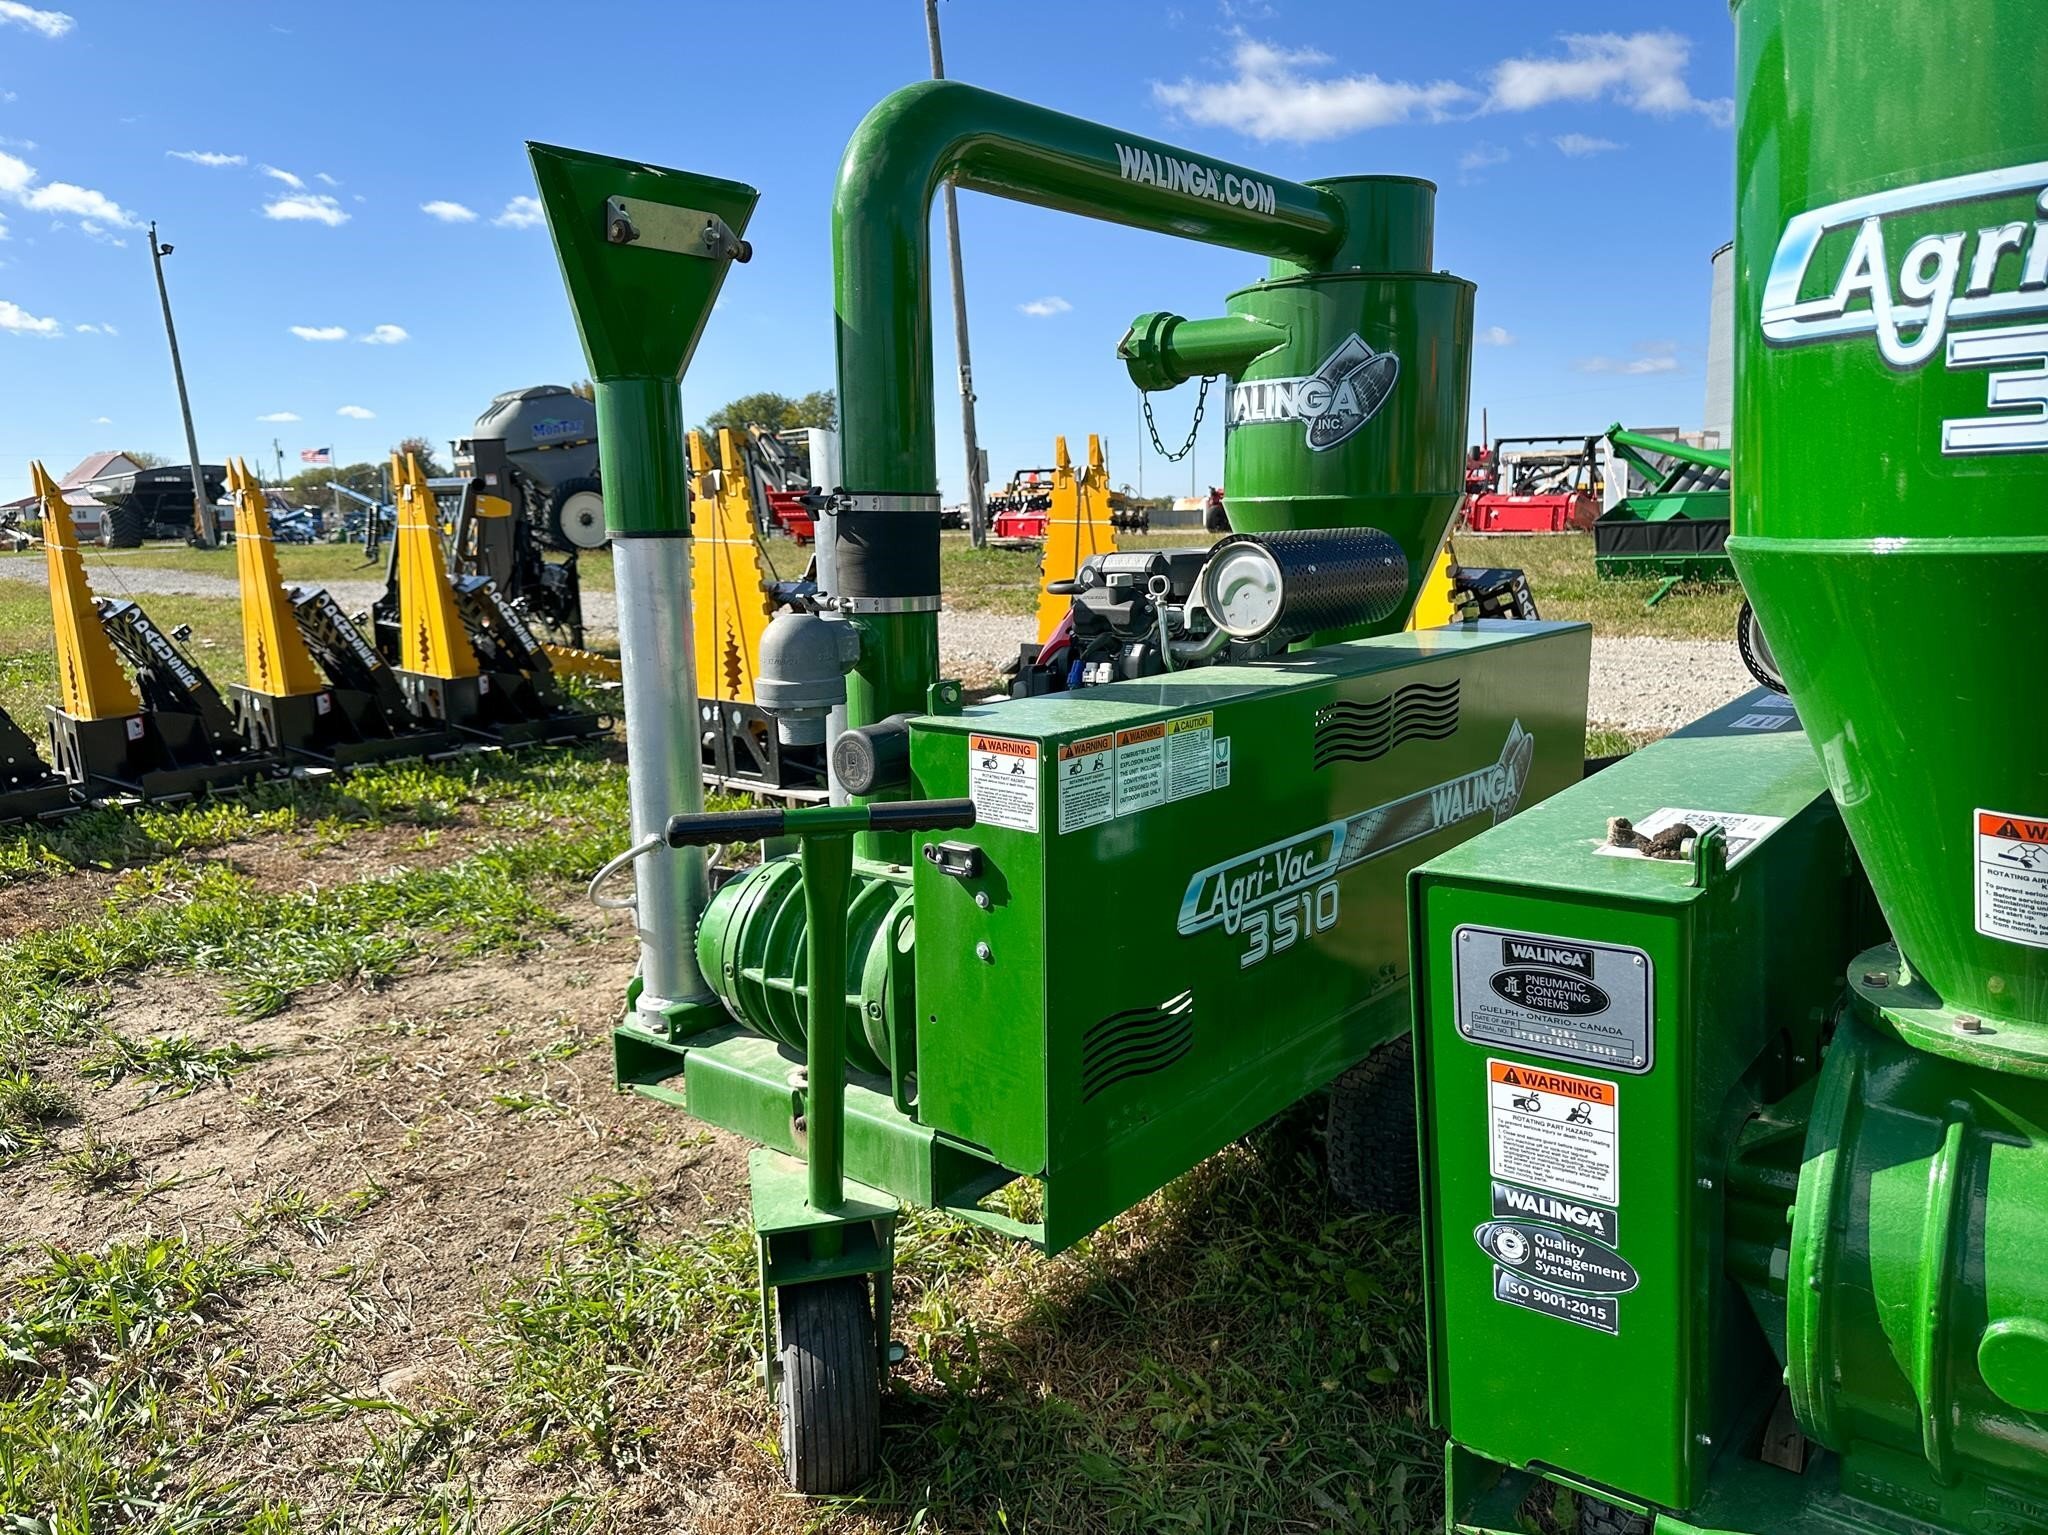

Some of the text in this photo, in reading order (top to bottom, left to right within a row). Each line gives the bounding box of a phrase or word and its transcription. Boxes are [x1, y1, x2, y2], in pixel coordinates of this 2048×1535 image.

[1232, 377, 1362, 422] ALINGA
[1318, 419, 1343, 430] INC.
[490, 592, 538, 652] DANUSER
[323, 604, 379, 668] DANUSER
[134, 620, 199, 689] DANUSER
[1180, 717, 1208, 730] CAUTION
[1129, 727, 1161, 741] WARNING
[988, 740, 1030, 755] WARNING
[1074, 739, 1108, 754] WARNING
[1120, 758, 1142, 768] EXPLOSION
[1431, 763, 1517, 828] WALINGA
[1987, 868, 2030, 882] ROTATING
[1211, 847, 1314, 935] Agri-Vac
[1993, 892, 2017, 901] Before
[1996, 885, 2023, 894] prevent
[1993, 897, 2035, 910] maintaining
[1993, 903, 2017, 912] source
[1993, 916, 2011, 924] Keep
[2006, 911, 2022, 919] start
[1241, 880, 1339, 969] 3510
[1993, 920, 2009, 928] from
[2011, 925, 2038, 935] moving
[1525, 974, 1586, 992] PNEUMATIC
[1525, 984, 1591, 1004] CONVEYING
[1525, 994, 1569, 1011] SYSTEMS
[1474, 1014, 1490, 1022] DATE
[1474, 1022, 1497, 1031] SERIAL
[1479, 1004, 1623, 1036] GUELPH ONTARIO CANADA
[1522, 1071, 1602, 1100] WARNING
[1512, 1115, 1544, 1126] ROTATING
[1565, 1127, 1593, 1137] HAZARD
[1504, 1189, 1604, 1230] WALINGA
[1534, 1233, 1585, 1258] Quality
[1534, 1247, 1627, 1282] Management
[1535, 1260, 1585, 1283] System
[1505, 1280, 1529, 1297] ISO
[1533, 1289, 1607, 1320] 9001:2015
